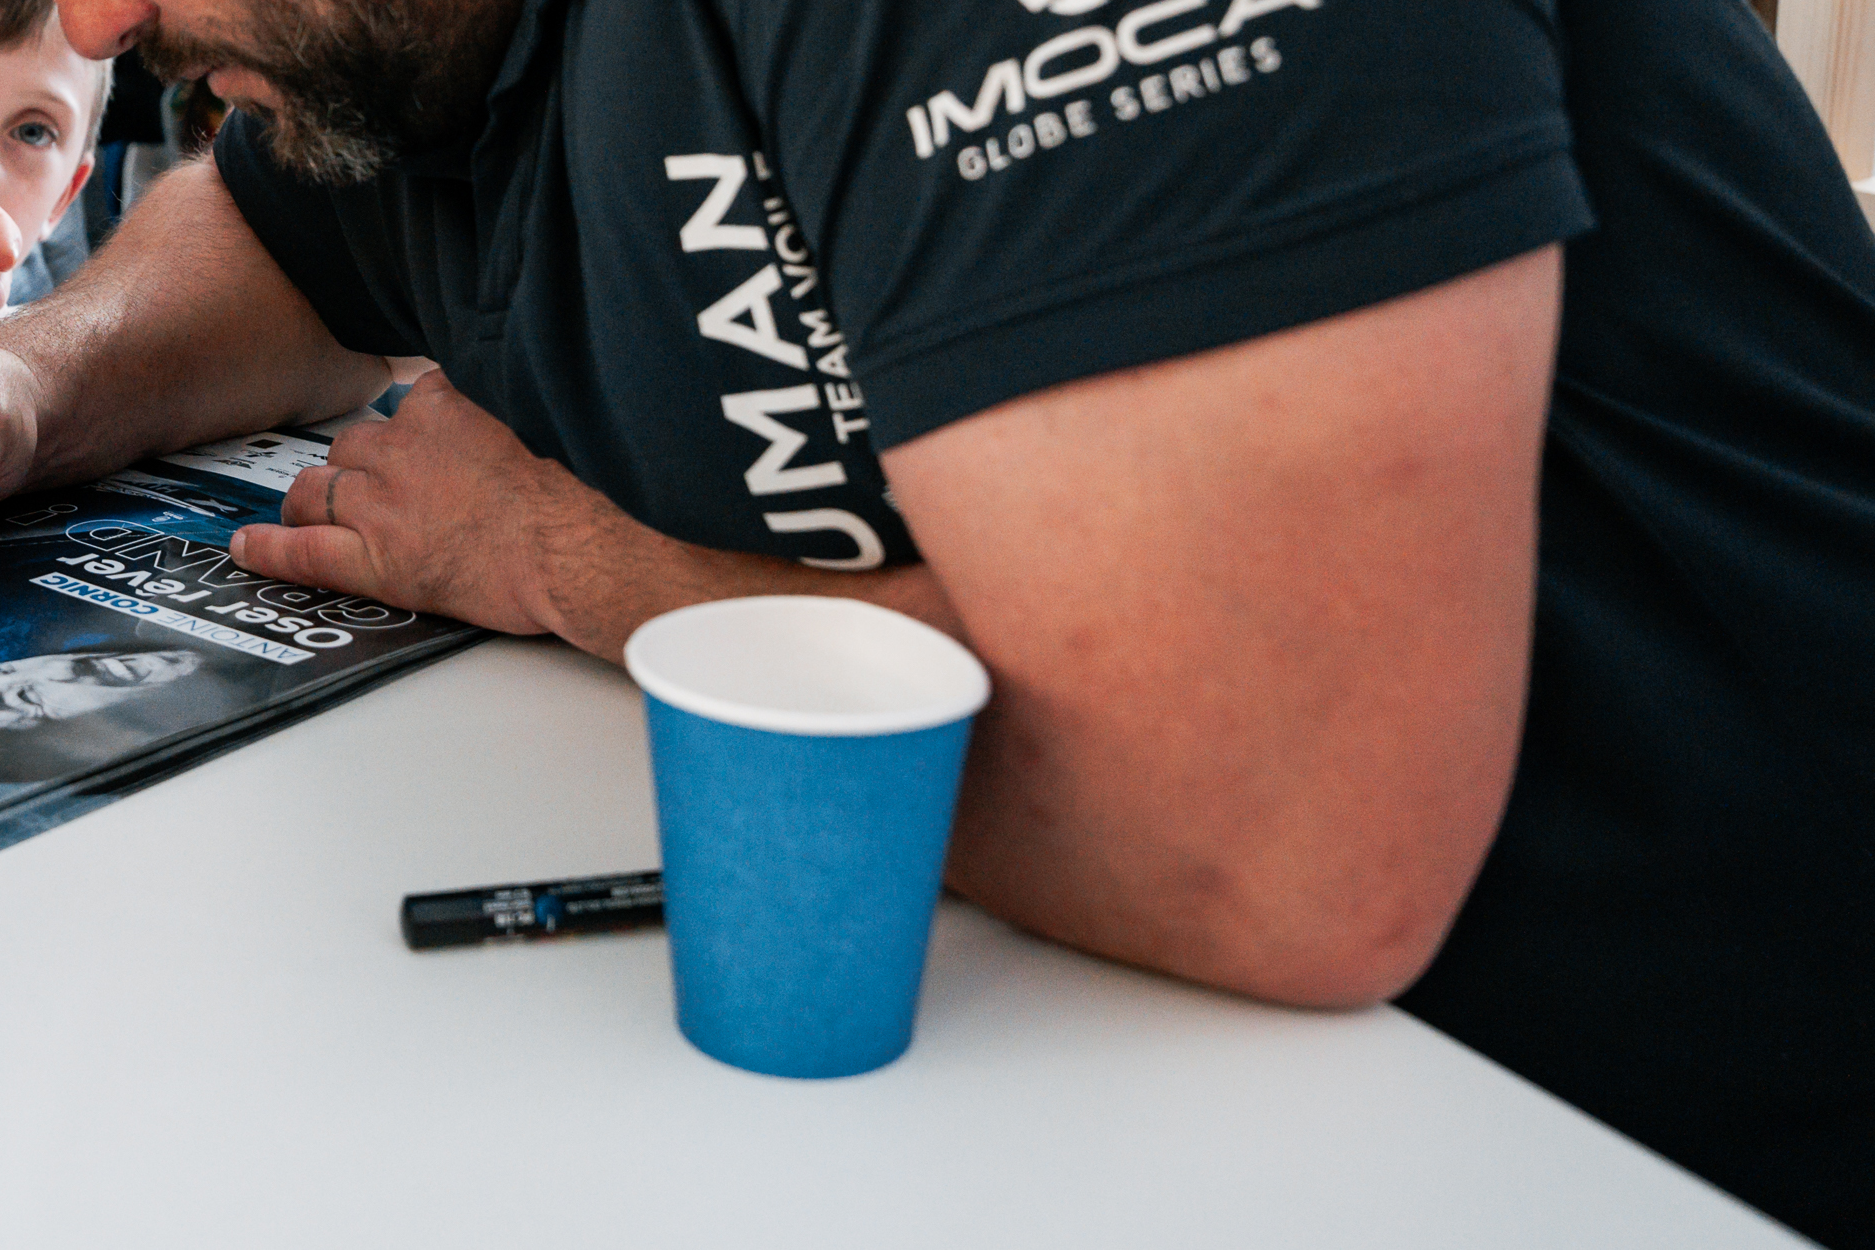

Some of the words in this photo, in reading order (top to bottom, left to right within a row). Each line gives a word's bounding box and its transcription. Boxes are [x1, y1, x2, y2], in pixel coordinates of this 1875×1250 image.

[957, 100, 1097, 181] GLOBE
[1110, 36, 1282, 122] SERIES
[664, 152, 885, 571] UMAN
[799, 309, 871, 444] TEAM
[40, 574, 159, 615] CORNIC
[56, 553, 210, 604] rêver
[156, 608, 309, 661] ANTOINE
[205, 601, 354, 648] Oser
